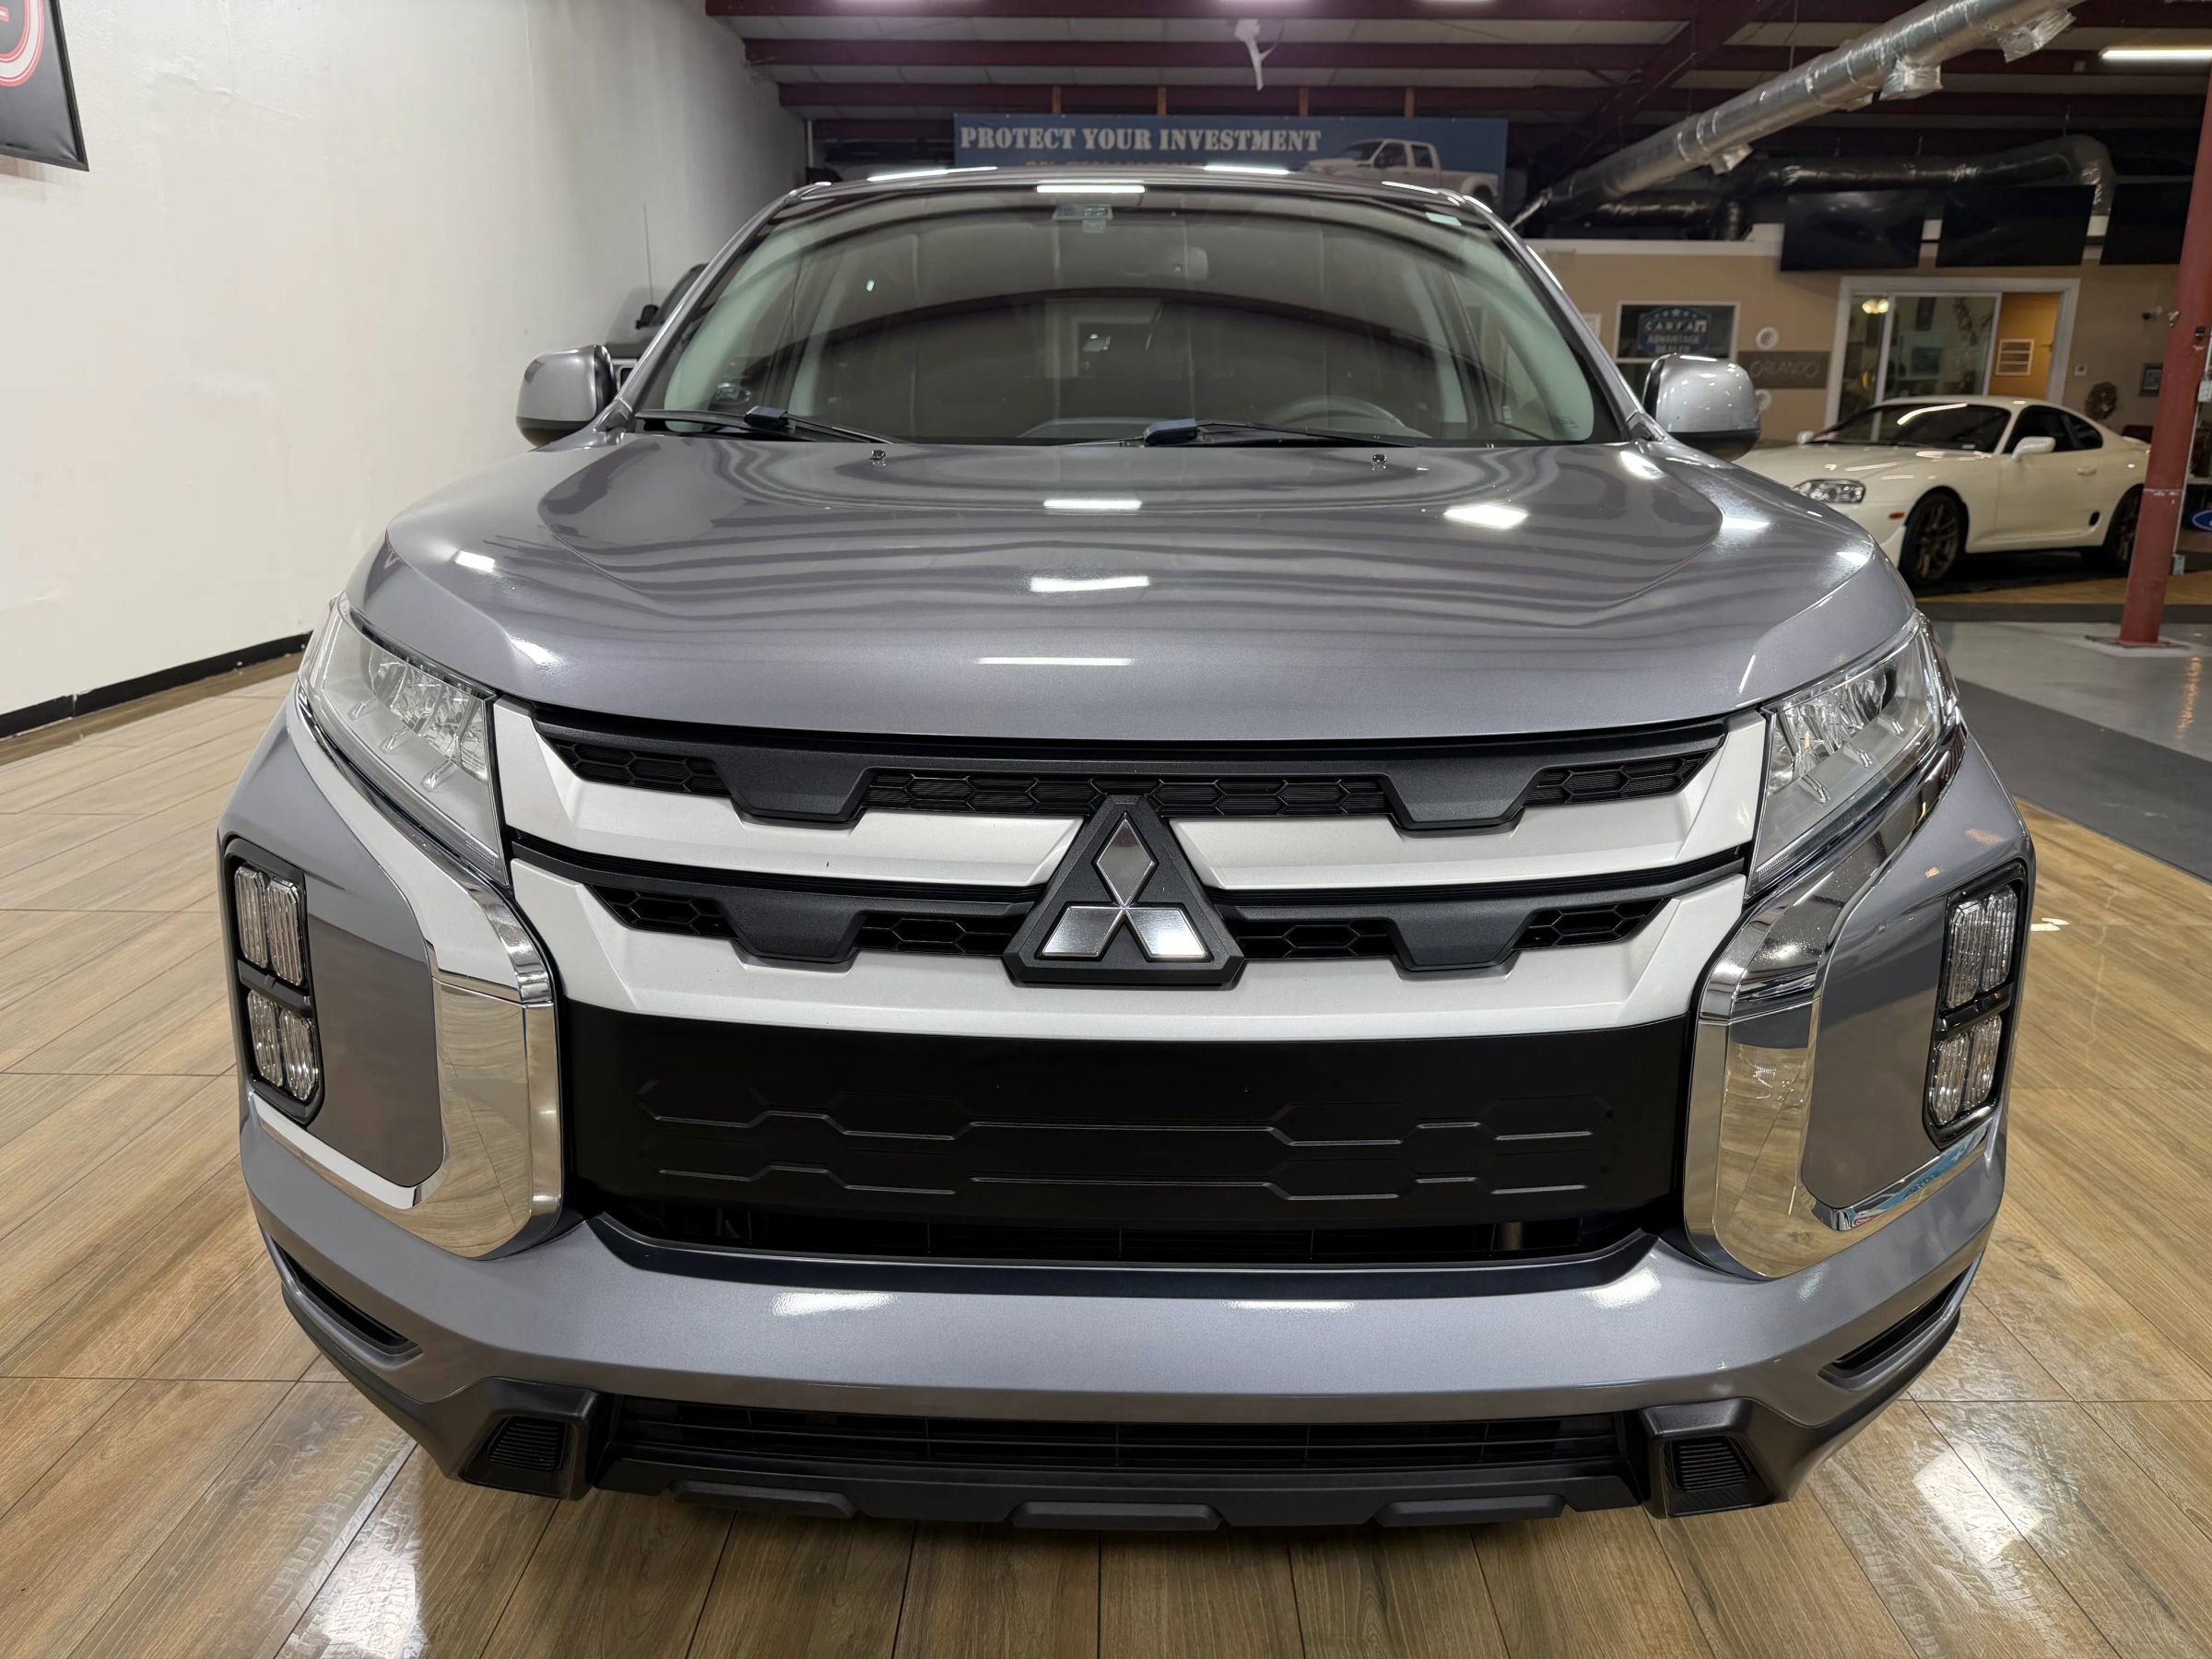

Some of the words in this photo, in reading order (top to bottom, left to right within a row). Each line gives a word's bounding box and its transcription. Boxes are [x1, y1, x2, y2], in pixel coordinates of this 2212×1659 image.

[960, 127, 1076, 148] PROTECT
[1082, 128, 1151, 150] YOUR
[1159, 129, 1322, 151] INVESTMENT
